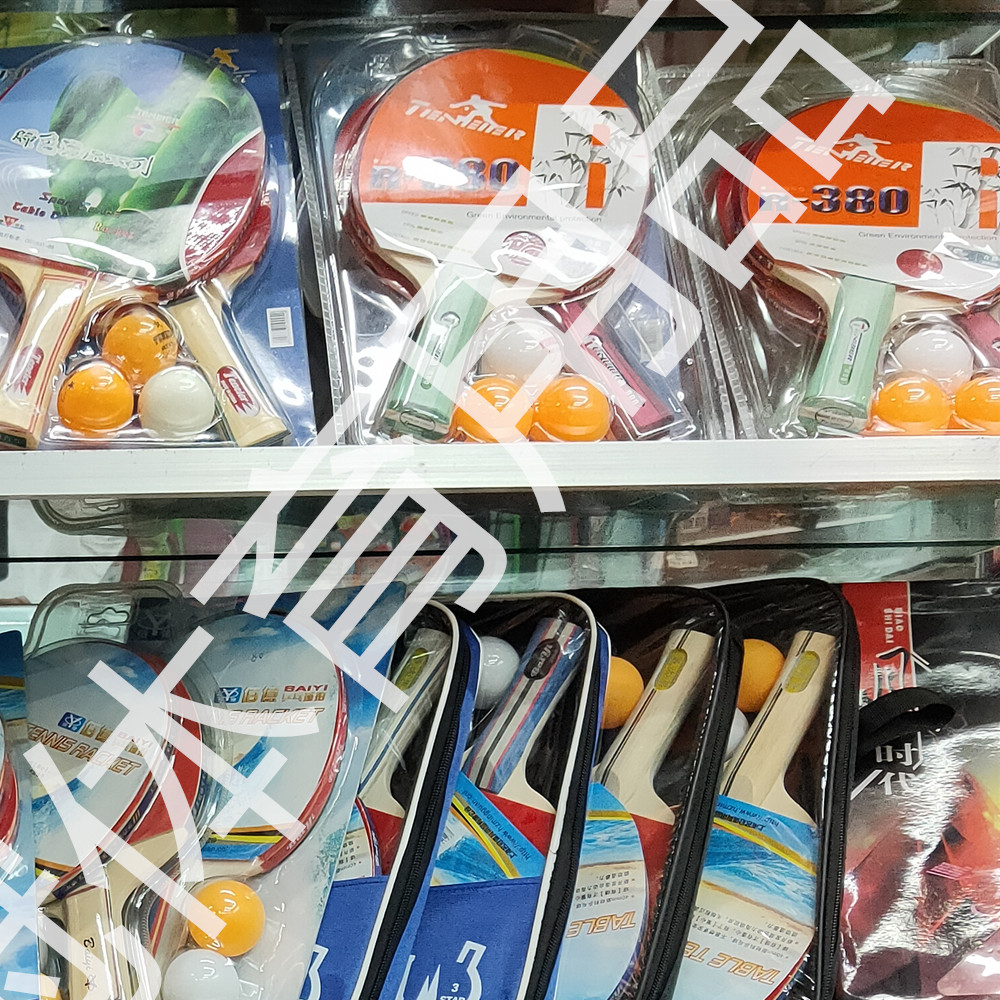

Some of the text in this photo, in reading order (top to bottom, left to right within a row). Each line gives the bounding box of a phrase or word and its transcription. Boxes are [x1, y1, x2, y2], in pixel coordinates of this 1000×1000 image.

[858, 231, 887, 239] Green
[885, 626, 895, 644] DAI
[283, 684, 329, 693] BAIYI
[68, 742, 143, 777] RACKET
[566, 911, 636, 938] TABLE
[706, 951, 781, 985] TABLE
[451, 982, 460, 993] 3
